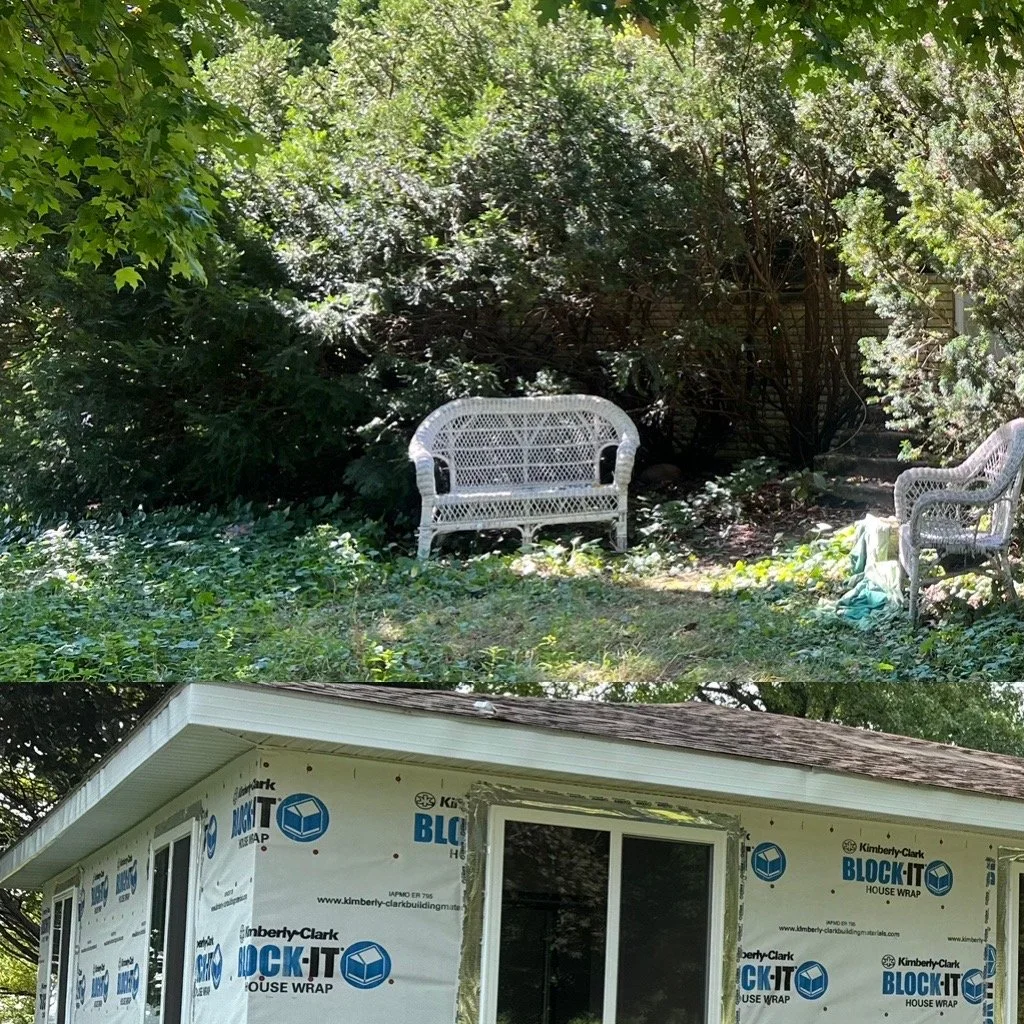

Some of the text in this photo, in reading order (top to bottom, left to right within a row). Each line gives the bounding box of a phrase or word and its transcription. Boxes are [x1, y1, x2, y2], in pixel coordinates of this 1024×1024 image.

[860, 842, 925, 859] Kimberly-Clark
[842, 857, 925, 887] BLOCK-IT
[865, 885, 921, 898] HOUSE WRAP
[898, 957, 960, 970] Kimberly-Clark
[245, 981, 333, 994] HOUSE WRAP
[882, 971, 962, 997] BLOCK-IT
[741, 994, 790, 1006] USE WRAP
[905, 998, 958, 1008] HOUSE WRAP
